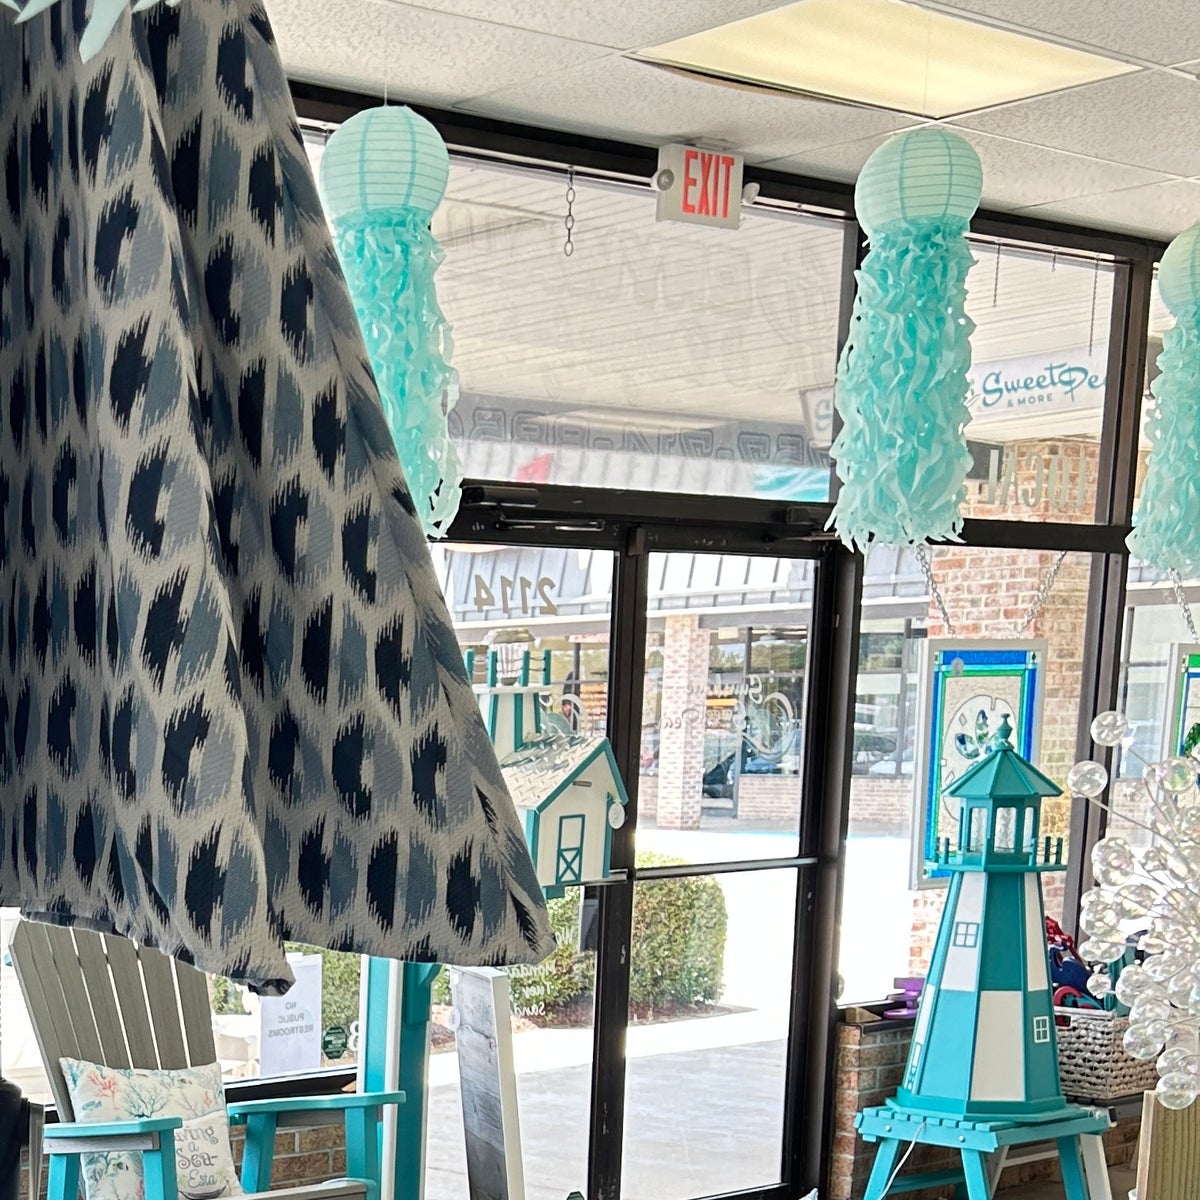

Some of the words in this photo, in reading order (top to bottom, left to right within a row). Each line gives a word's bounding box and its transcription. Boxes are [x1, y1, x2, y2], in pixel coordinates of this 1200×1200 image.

[682, 149, 735, 219] EXIT
[1017, 392, 1054, 407] MORE
[188, 1141, 199, 1153] a
[176, 1147, 218, 1170] Sea-
[187, 1168, 218, 1189] Esta
